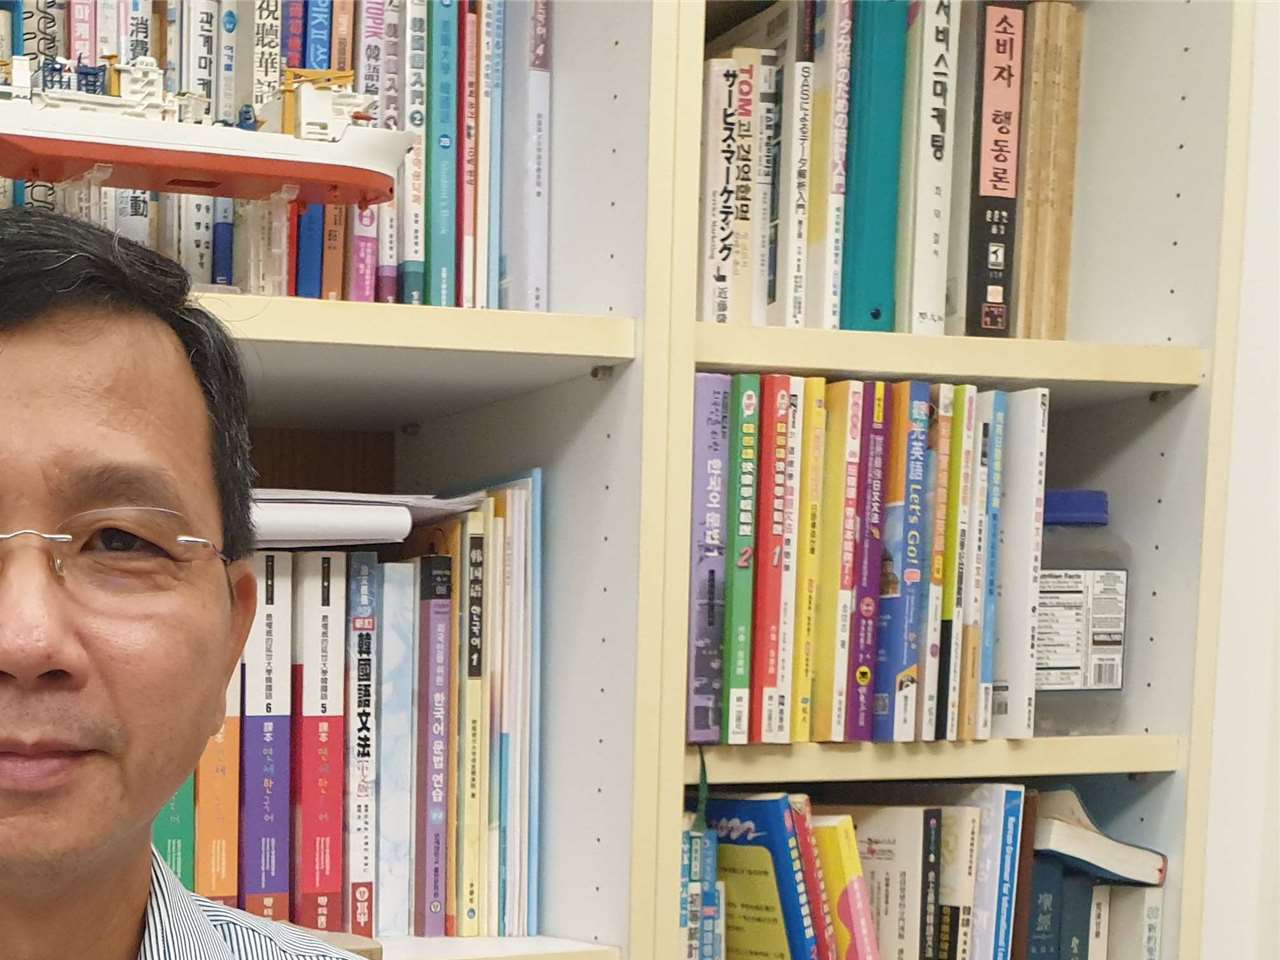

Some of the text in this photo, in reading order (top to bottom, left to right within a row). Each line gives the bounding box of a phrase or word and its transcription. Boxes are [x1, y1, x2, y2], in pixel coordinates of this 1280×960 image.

[992, 14, 1017, 89] 소비자
[930, 0, 953, 162] 서비스마케팅
[989, 110, 1013, 191] 행동론
[906, 483, 923, 564] Let's Go!
[737, 548, 753, 568] 2
[772, 545, 783, 567] 1
[265, 702, 272, 713] 6
[321, 703, 327, 714] 5
[1006, 816, 1016, 845] Korean
[1004, 846, 1014, 882] Grammar
[1003, 882, 1011, 895] for
[999, 896, 1010, 946] International
